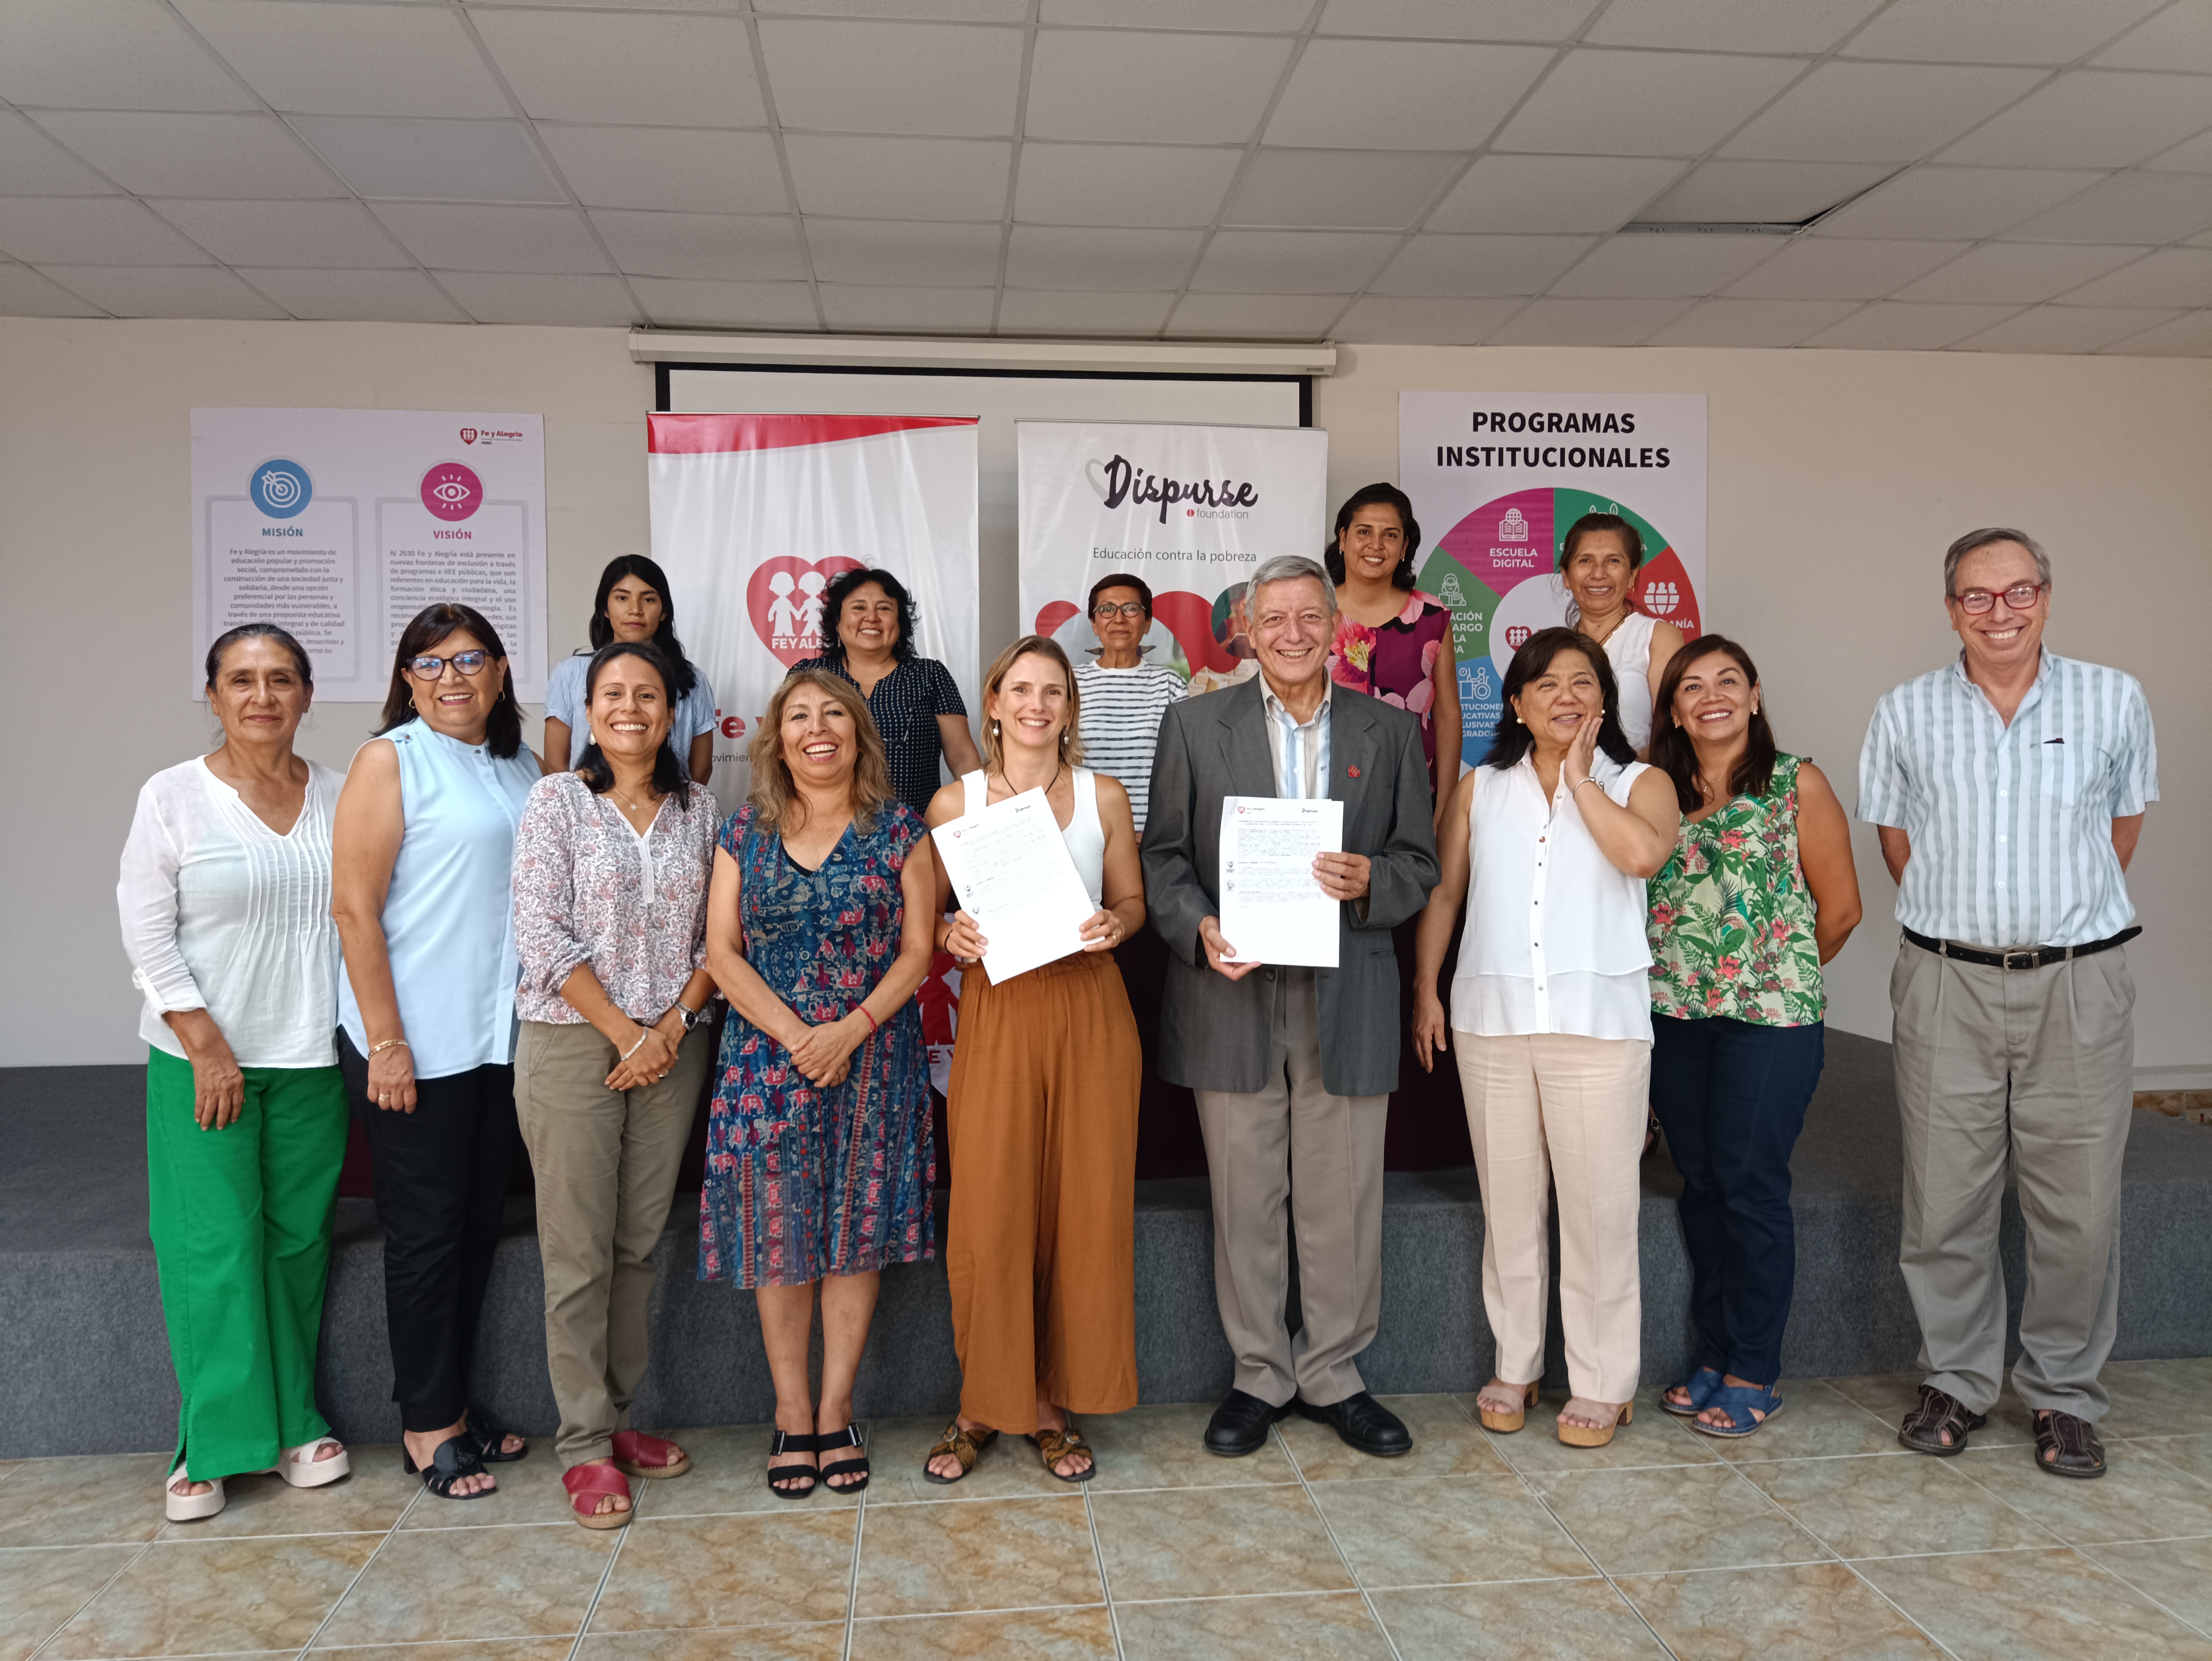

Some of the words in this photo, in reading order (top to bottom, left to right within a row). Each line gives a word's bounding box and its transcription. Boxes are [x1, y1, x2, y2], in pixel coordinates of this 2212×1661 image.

[1472, 412, 1635, 433] PROGRAMAS
[1438, 446, 1670, 468] INSTITUCIONALES
[1104, 454, 1258, 524] Dispurse
[1197, 509, 1249, 519] foundation
[262, 526, 303, 537] MISIÓN
[433, 529, 472, 540] VISIÓN
[1094, 548, 1151, 560] Educación
[1155, 551, 1193, 560] contra
[1197, 550, 1206, 561] la
[1210, 551, 1256, 564] pobreza
[1490, 548, 1538, 556] ESCUELA
[1493, 559, 1535, 568] DIGITAL
[1450, 610, 1482, 621] ACIÓN
[1452, 623, 1482, 631] ARGO
[772, 638, 823, 649] FEYALE
